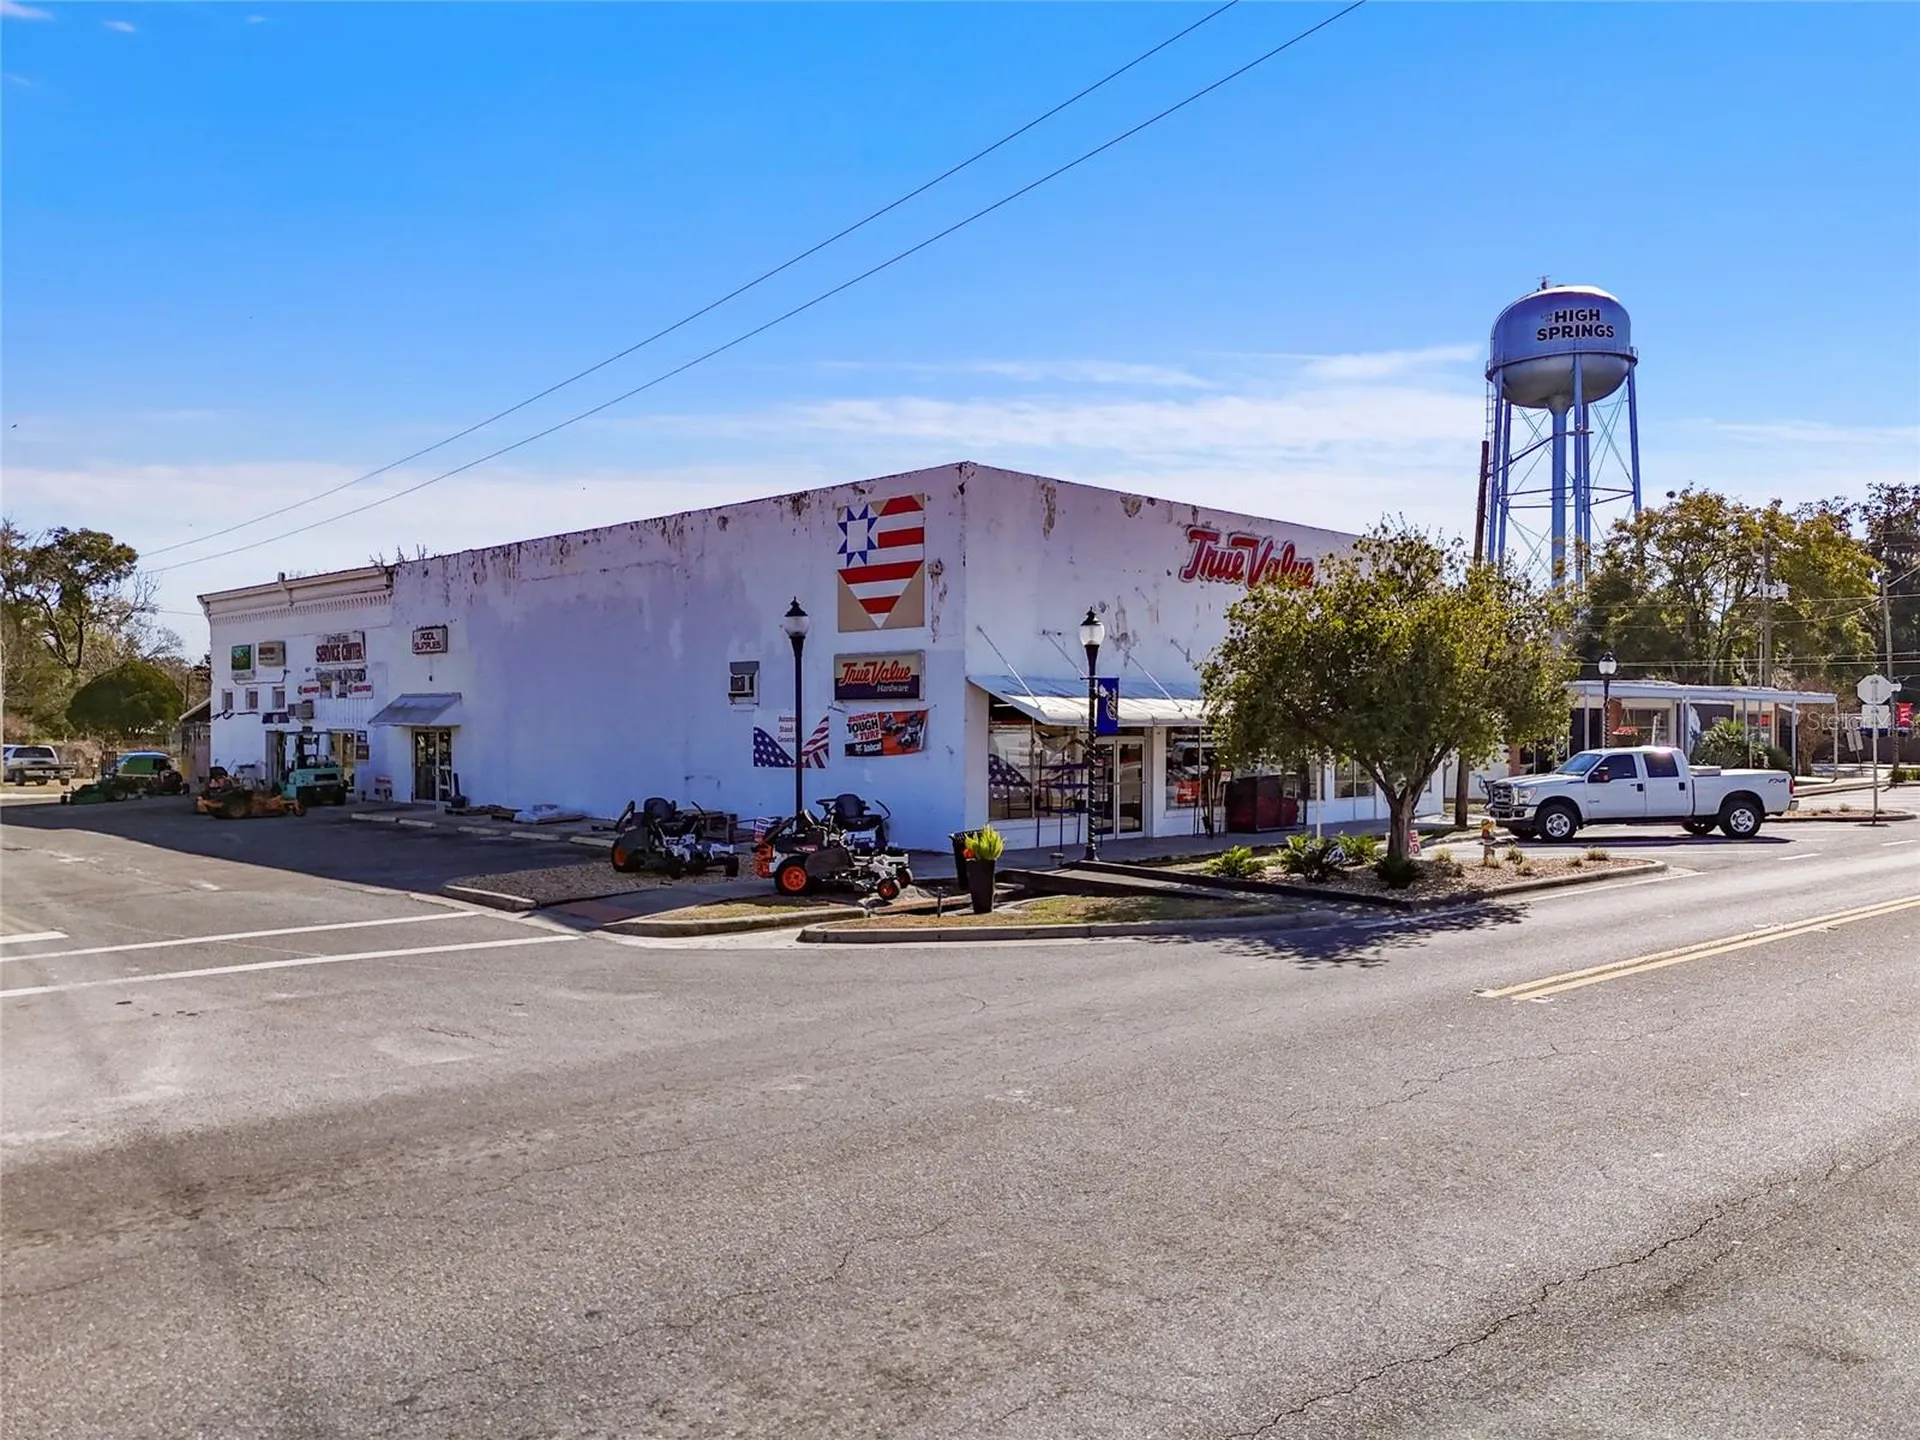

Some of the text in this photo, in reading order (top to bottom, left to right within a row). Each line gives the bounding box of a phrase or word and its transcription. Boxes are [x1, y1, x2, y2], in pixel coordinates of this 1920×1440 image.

[1554, 309, 1601, 323] HIGH
[1536, 324, 1614, 341] SPRINGS
[1182, 528, 1245, 581] True
[839, 660, 911, 687] True Value
[876, 684, 909, 692] Hardware
[846, 718, 878, 733] TOUGH
[859, 729, 880, 740] TURF
